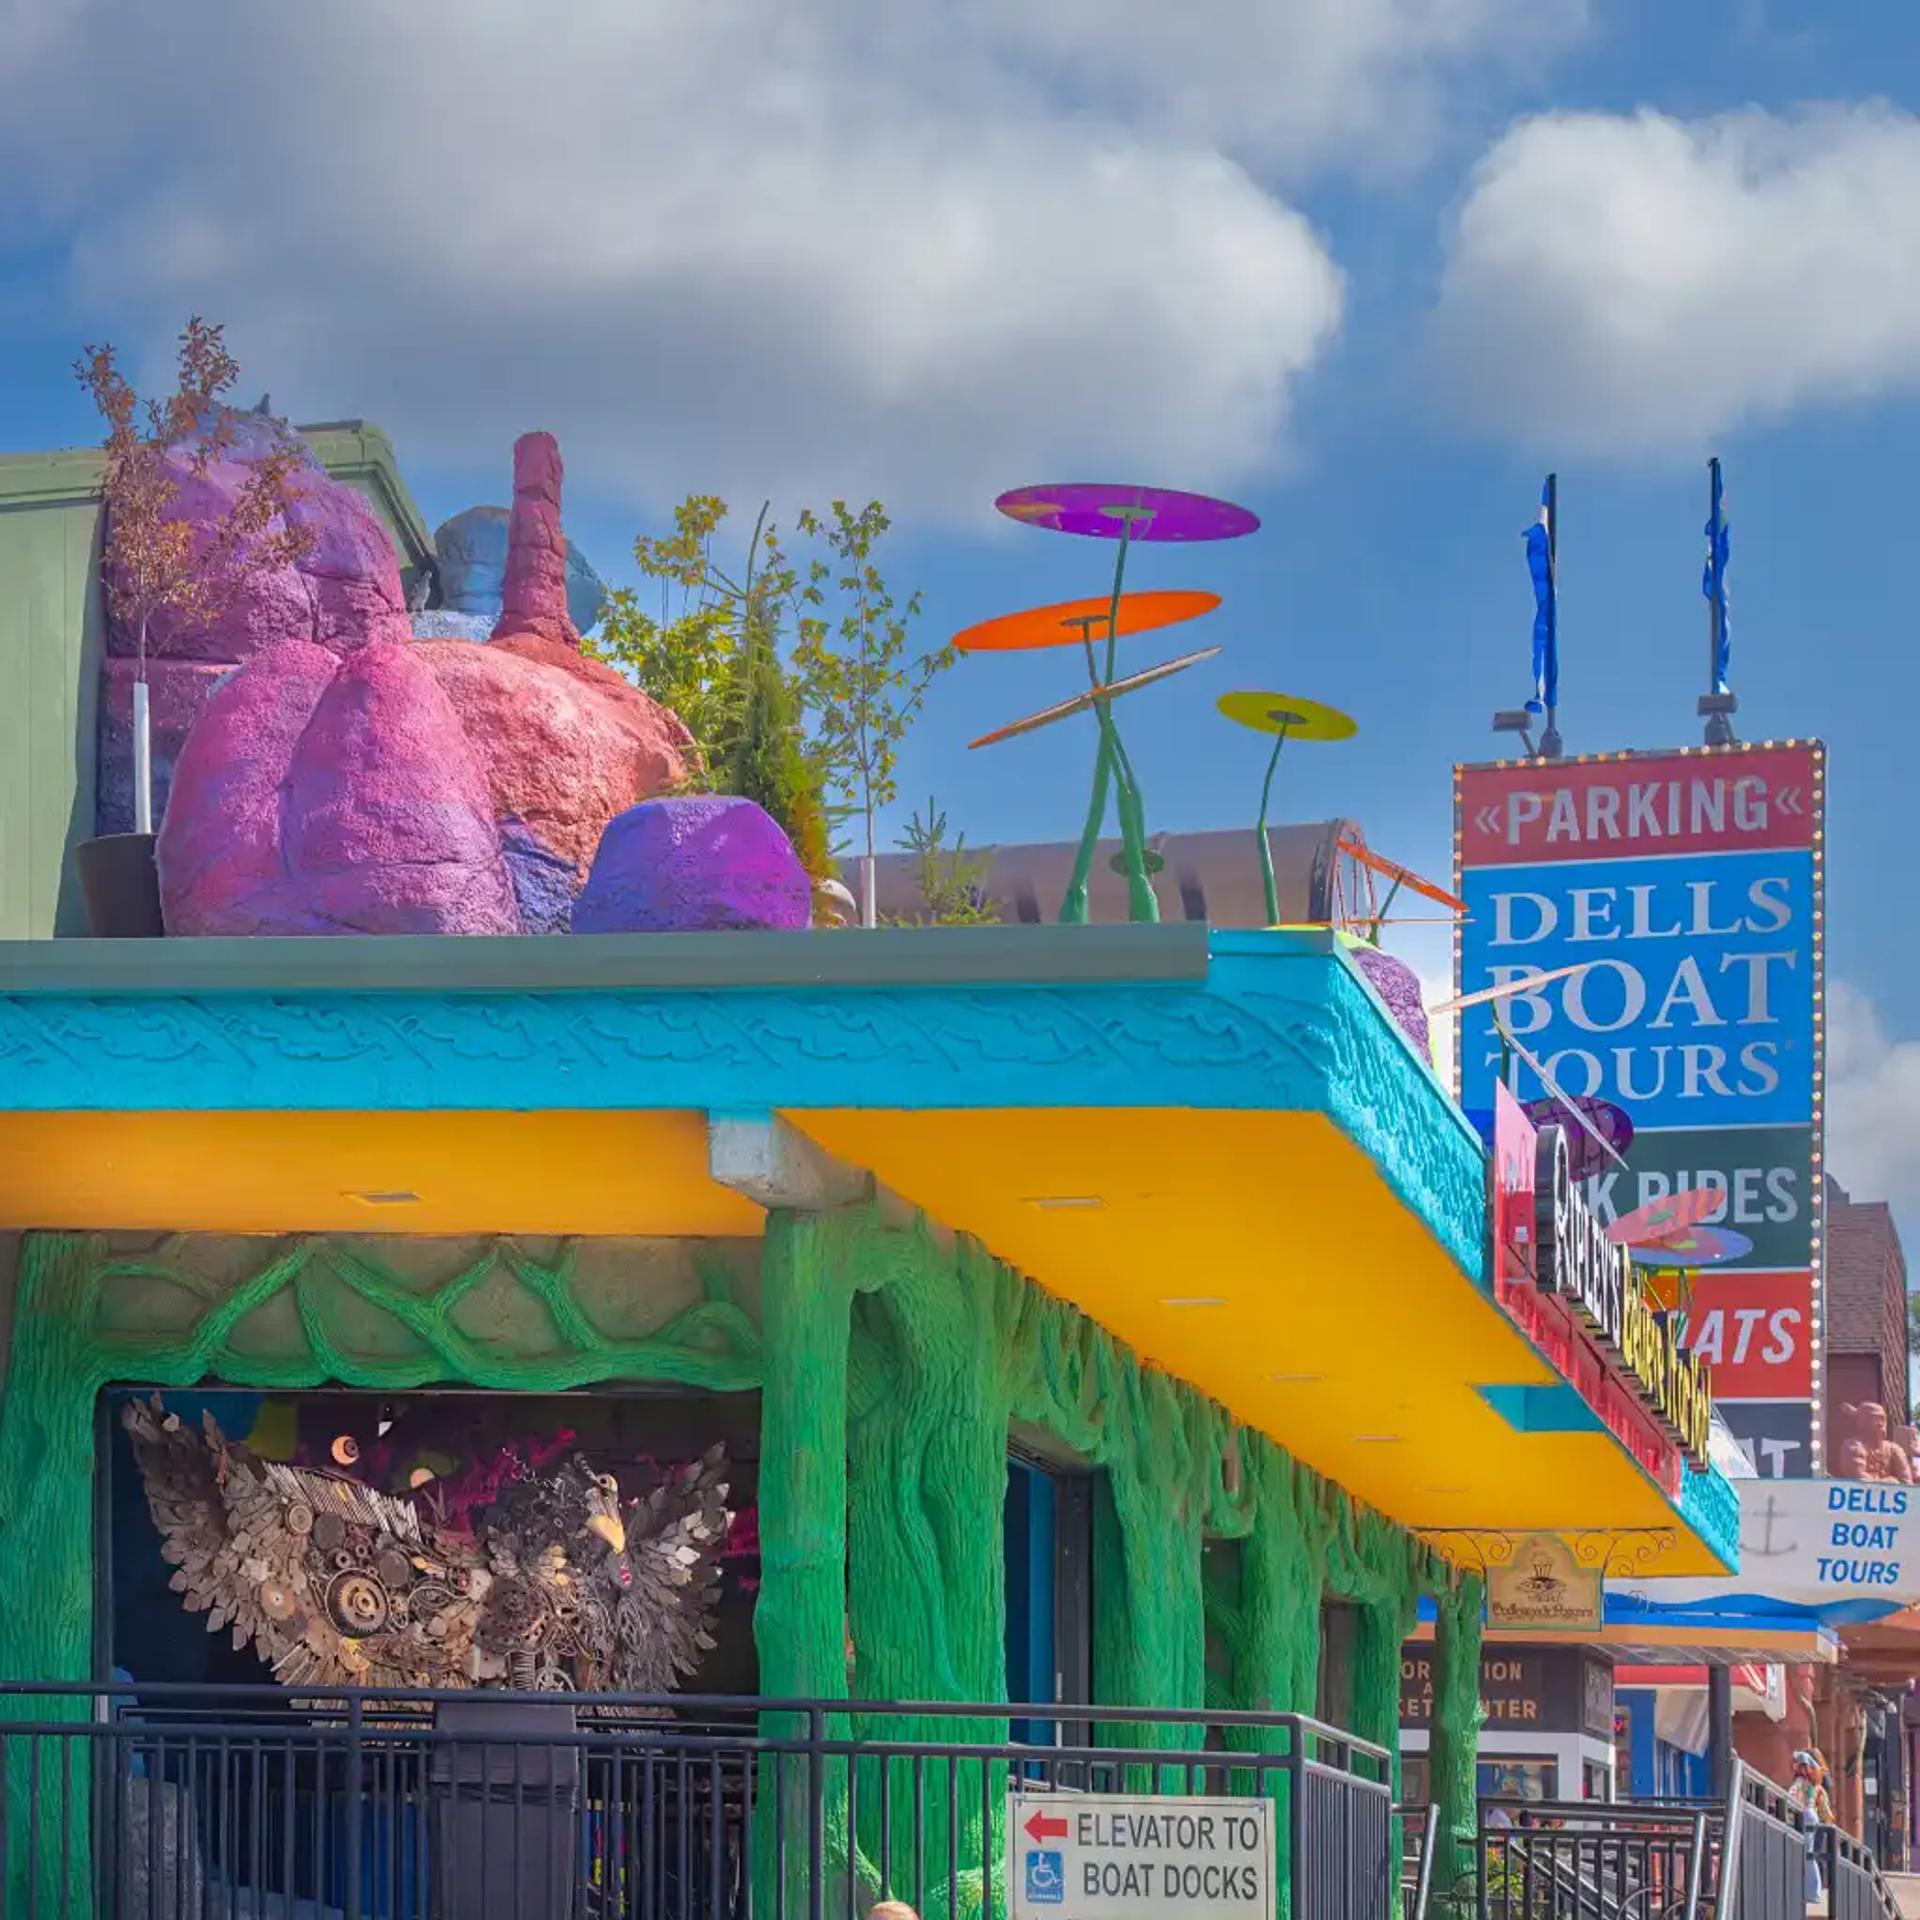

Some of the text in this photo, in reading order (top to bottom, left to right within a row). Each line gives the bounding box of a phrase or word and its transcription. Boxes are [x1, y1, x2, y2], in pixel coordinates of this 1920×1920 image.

[1507, 775, 1768, 846] PARKING
[1487, 876, 1792, 947] DELLS
[1484, 948, 1797, 1036] BOAT
[1485, 1041, 1780, 1104] TOURS
[1691, 1308, 1801, 1365] ATS
[1828, 1486, 1908, 1514] DELLS
[1831, 1522, 1899, 1549] BOAT
[1817, 1558, 1900, 1585] TOURS
[1077, 1813, 1258, 1851] ELEVATOR TO
[1083, 1861, 1258, 1900] BOAT DOCKS
